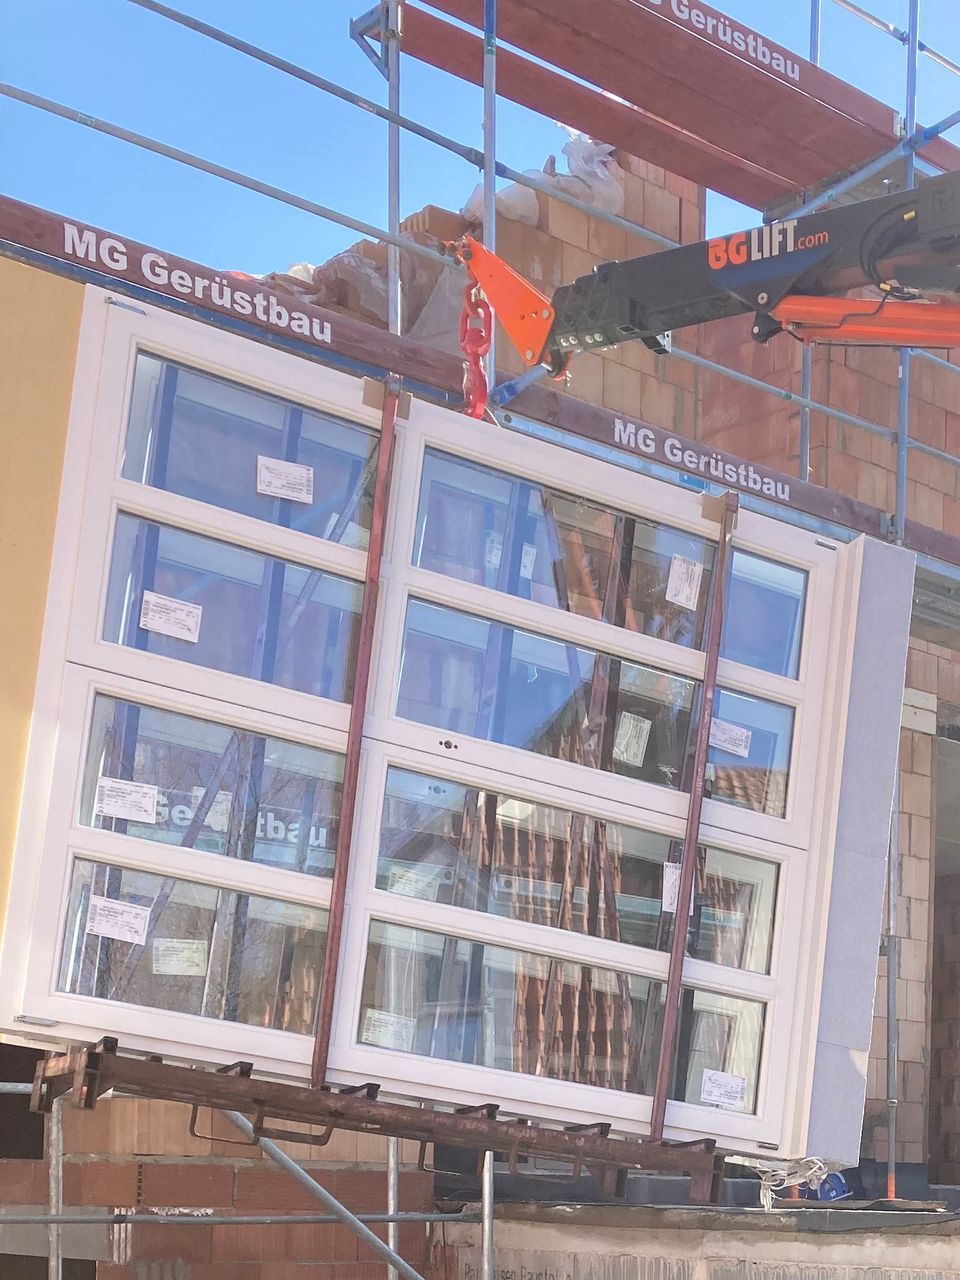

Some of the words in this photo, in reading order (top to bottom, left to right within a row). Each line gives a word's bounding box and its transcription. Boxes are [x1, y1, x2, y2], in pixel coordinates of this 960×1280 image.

[671, 0, 800, 81] Gerüstbau
[63, 222, 128, 271] MG
[140, 252, 332, 343] Gerüstbau
[614, 418, 656, 454] MG
[664, 437, 790, 501] Gerüstbau
